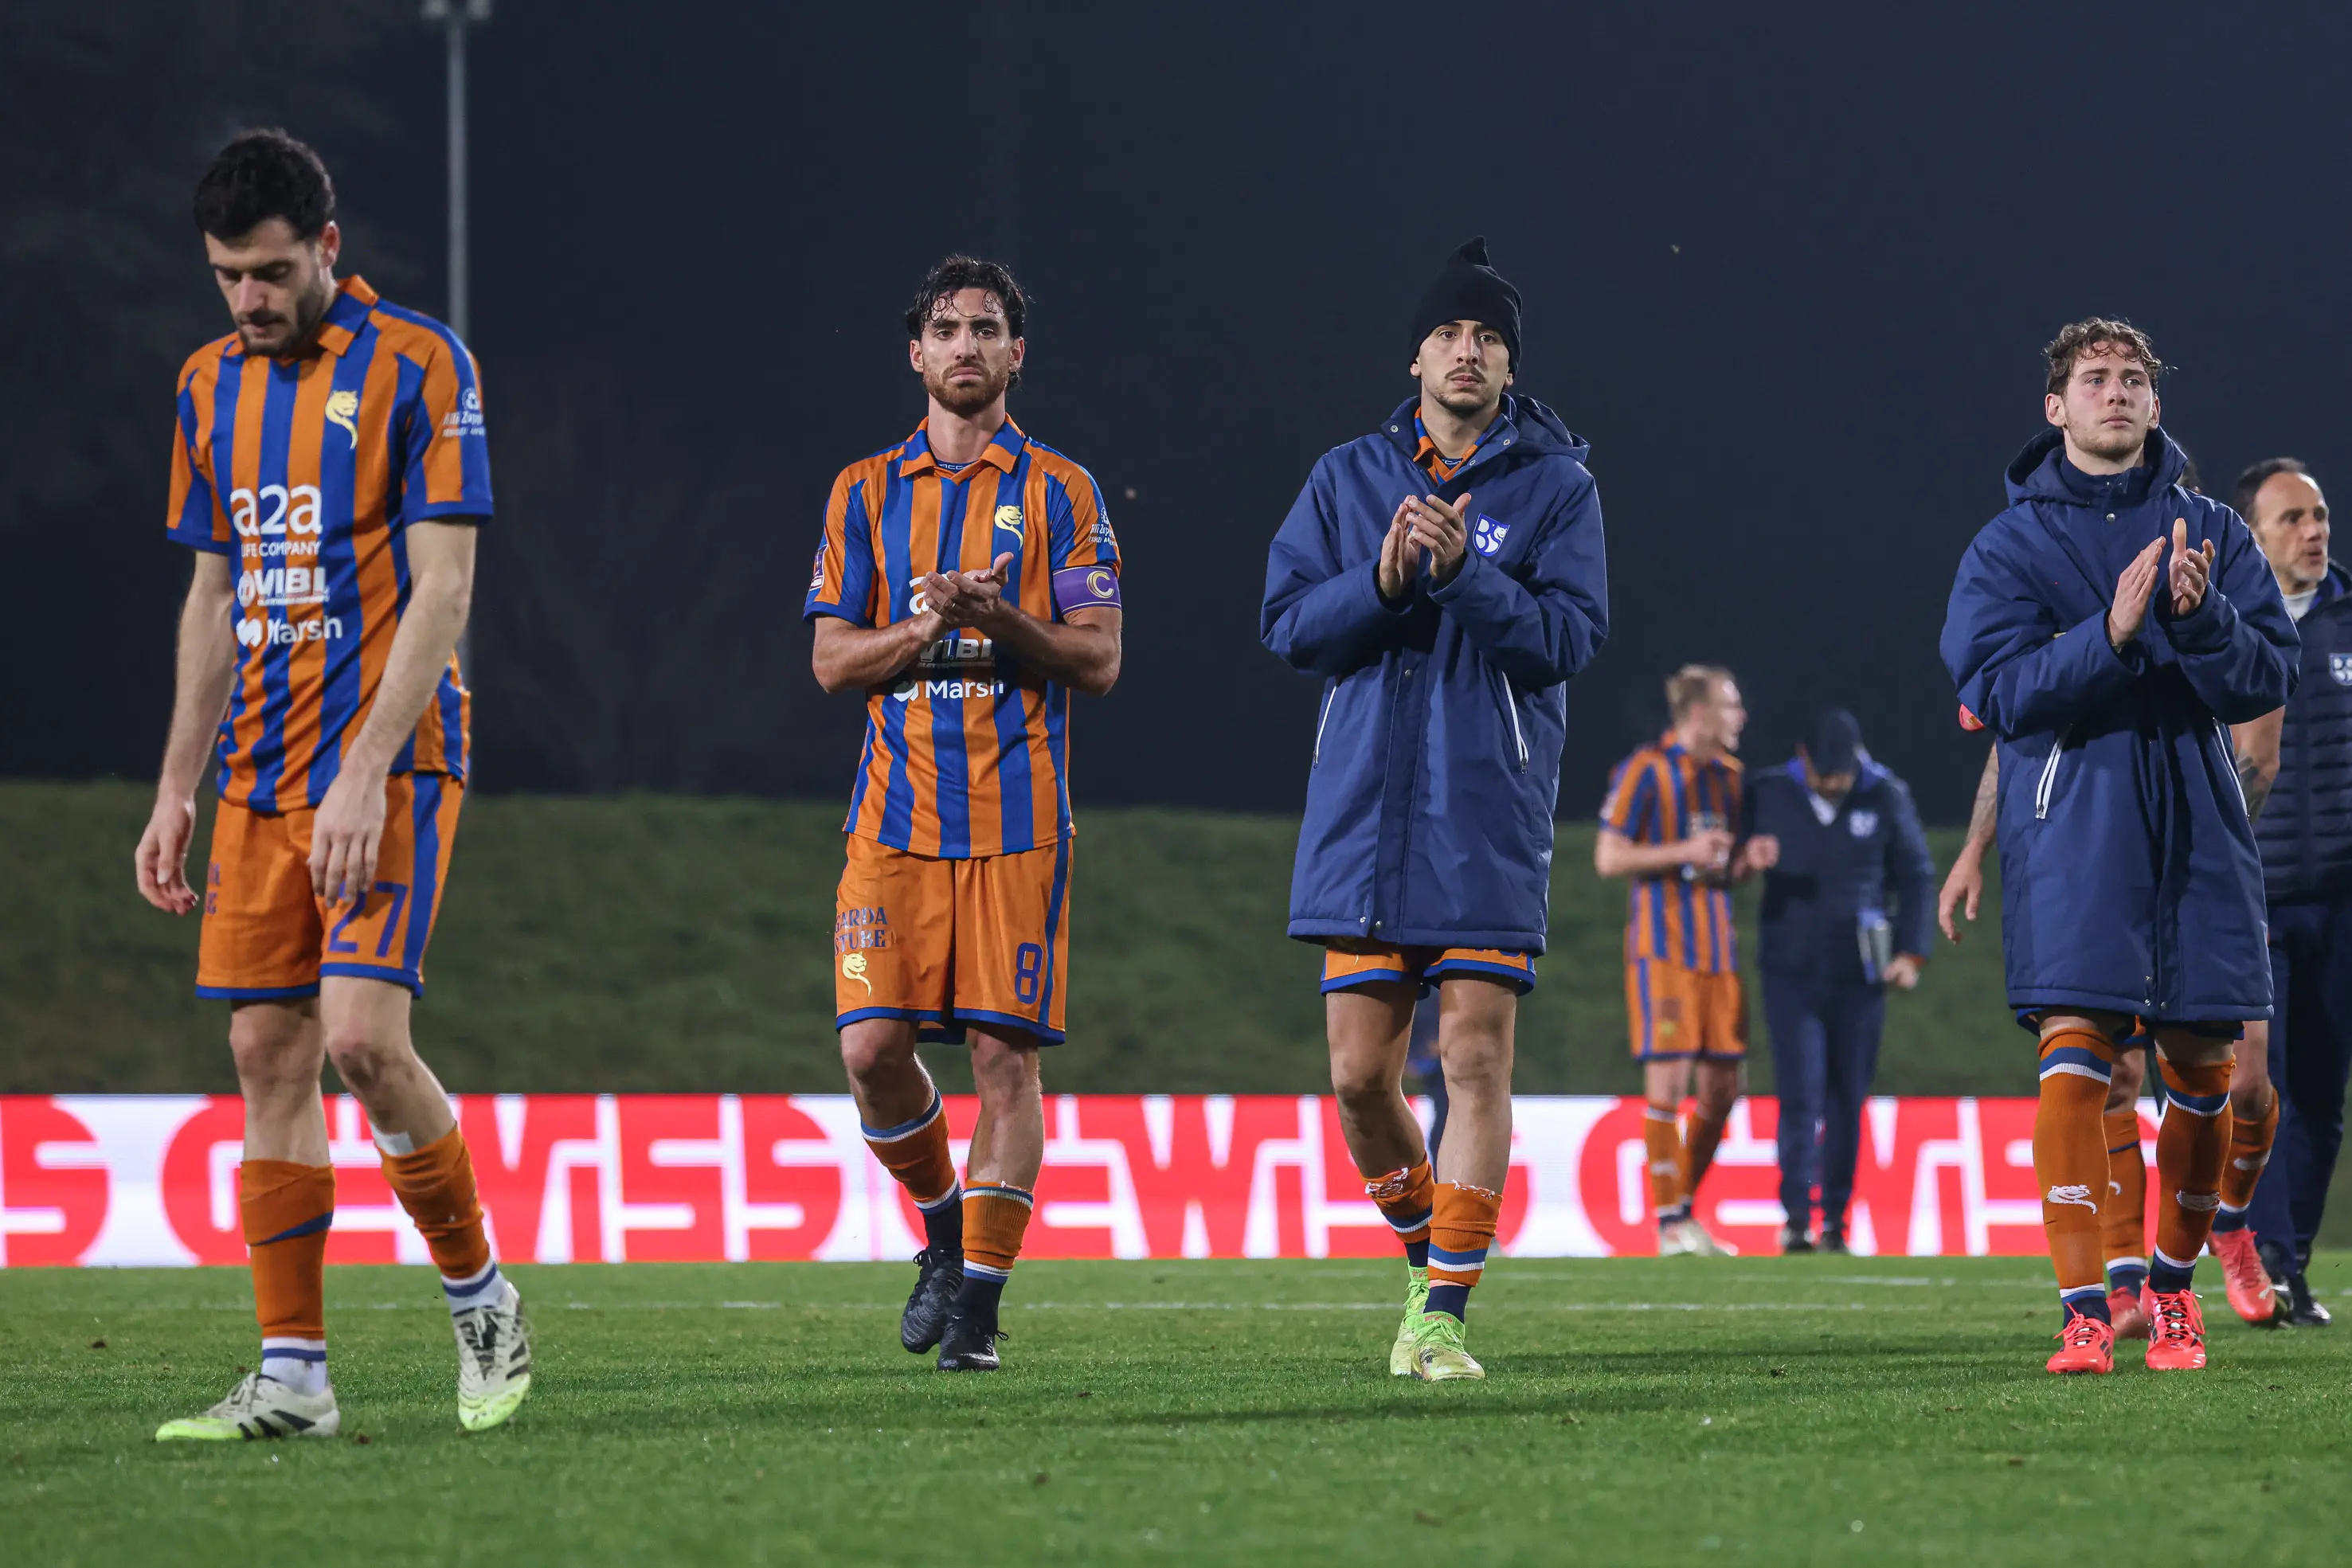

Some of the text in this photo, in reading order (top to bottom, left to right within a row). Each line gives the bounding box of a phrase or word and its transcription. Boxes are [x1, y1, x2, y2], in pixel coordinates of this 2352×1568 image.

[230, 484, 323, 537] a2a
[241, 541, 322, 557] LIFE COMPANY
[1086, 570, 1115, 599] C
[266, 615, 342, 644] Marsh
[925, 678, 1004, 699] Marsh
[327, 880, 409, 958] 27
[835, 906, 888, 933] GARDA
[834, 929, 886, 956] STUBE
[1014, 941, 1043, 1005] 8
